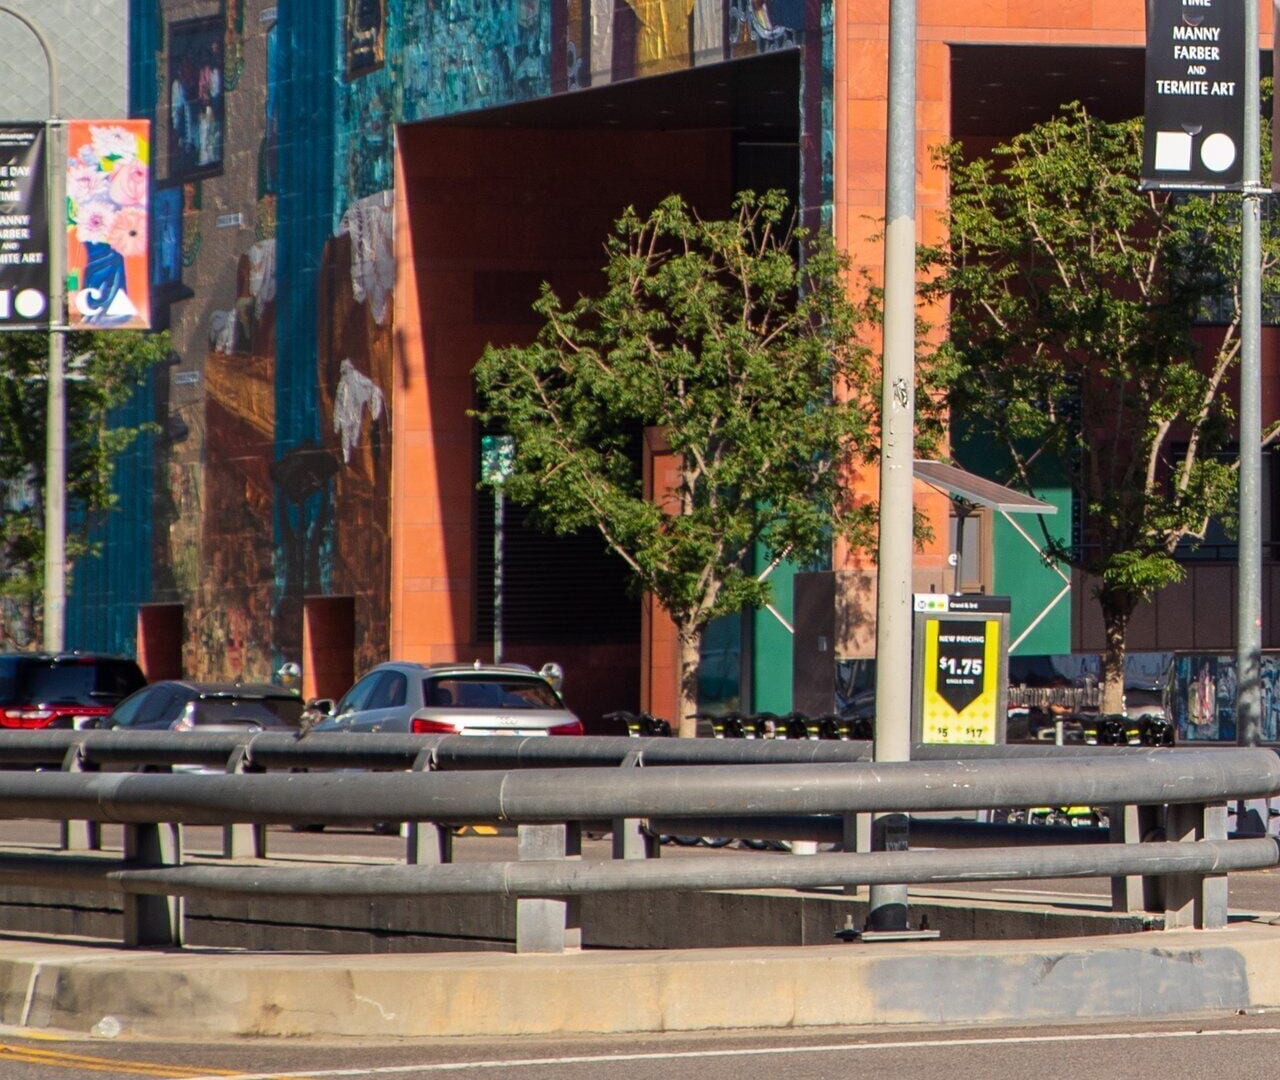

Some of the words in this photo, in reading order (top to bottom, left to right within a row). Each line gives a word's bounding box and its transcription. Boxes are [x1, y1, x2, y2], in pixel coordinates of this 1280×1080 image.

[1173, 26, 1220, 41] MANNY
[1174, 46, 1220, 60] FARBER
[1187, 65, 1206, 75] AND
[1156, 81, 1208, 95] TERMITE
[1210, 82, 1235, 96] ART
[10, 166, 30, 176] DAY
[1, 242, 20, 250] AND
[22, 253, 43, 264] ART
[939, 656, 982, 675] $1.75
[938, 727, 948, 738] $5
[966, 728, 983, 738] $17
